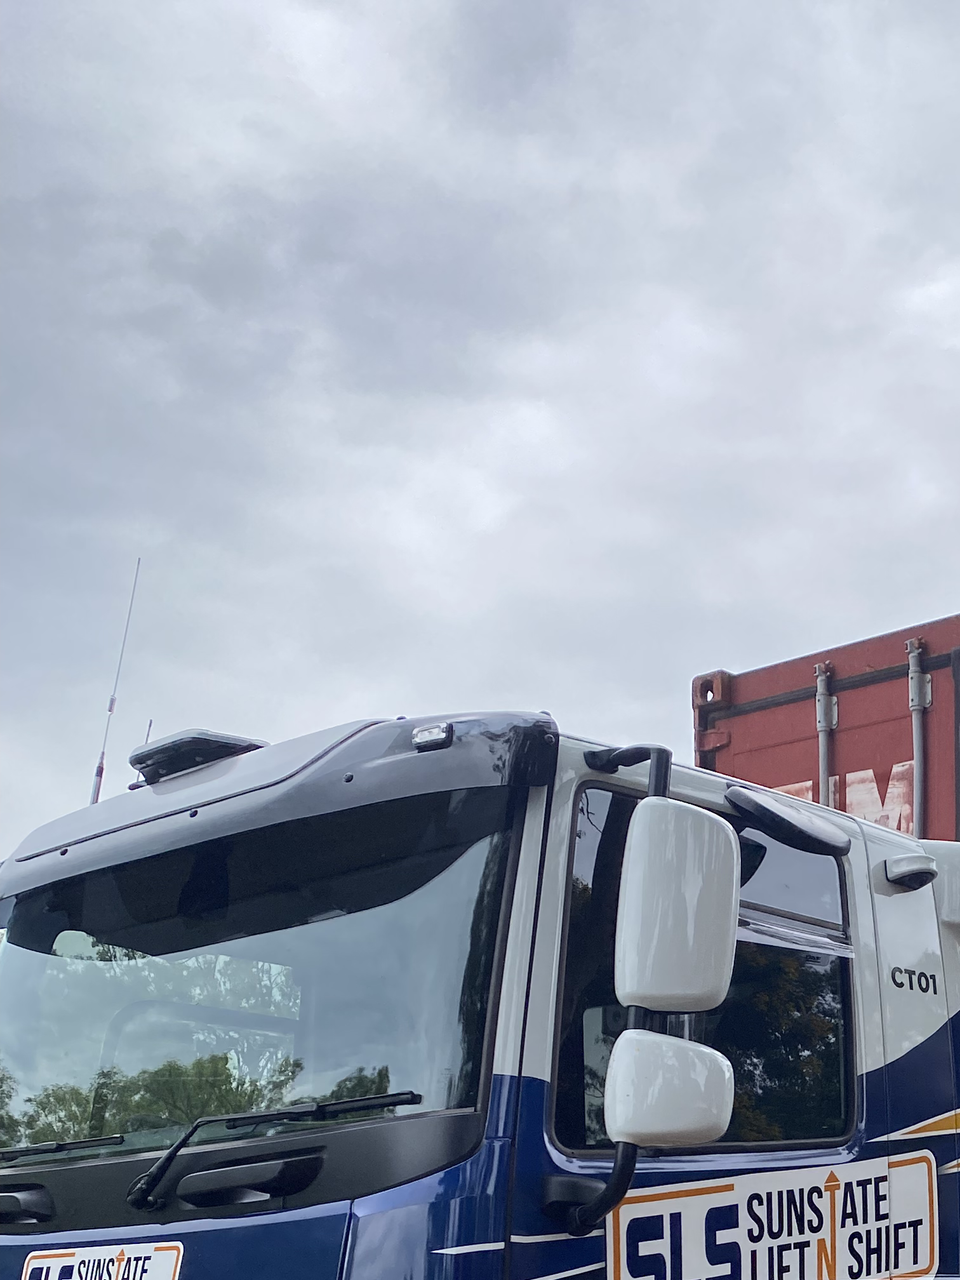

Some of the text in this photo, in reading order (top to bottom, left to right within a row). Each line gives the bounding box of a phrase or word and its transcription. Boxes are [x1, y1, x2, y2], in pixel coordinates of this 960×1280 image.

[891, 966, 938, 995] CT01
[746, 1171, 891, 1244] SUNSTATE
[847, 1219, 924, 1280] SHIFT
